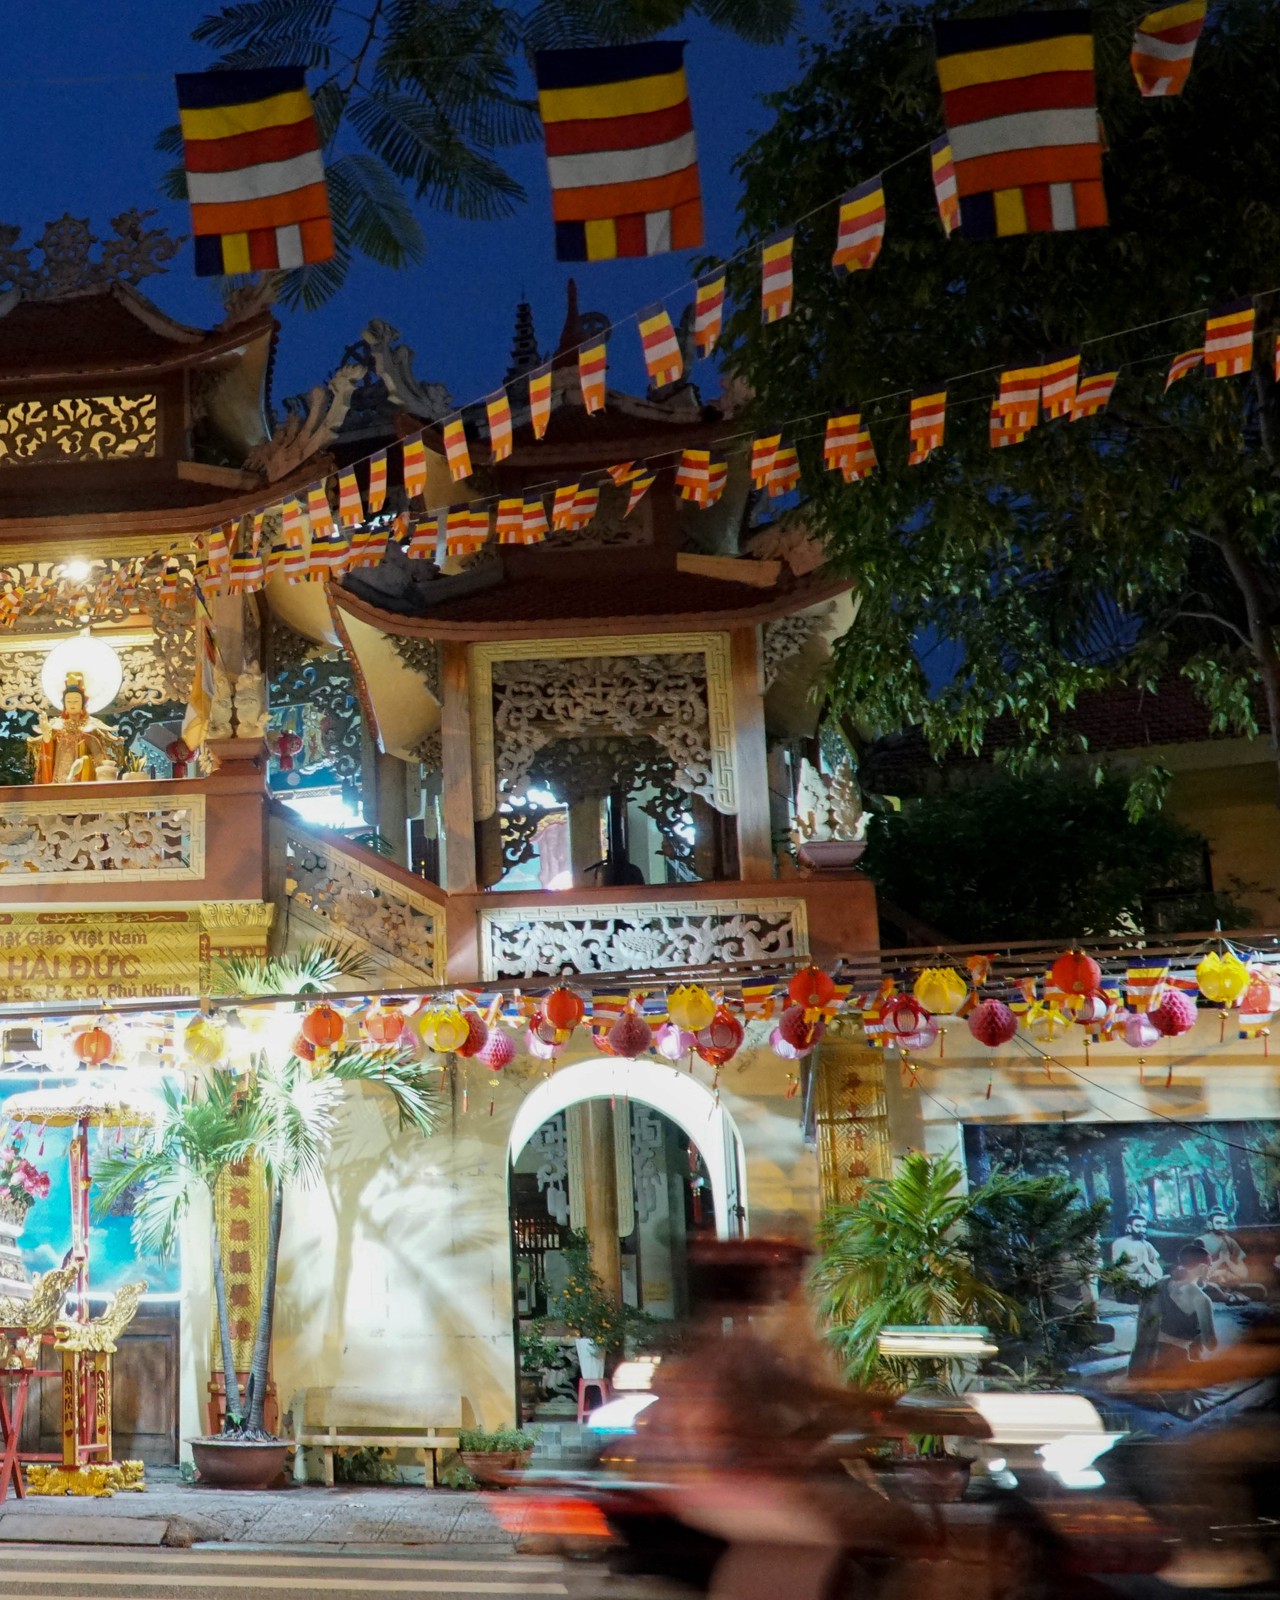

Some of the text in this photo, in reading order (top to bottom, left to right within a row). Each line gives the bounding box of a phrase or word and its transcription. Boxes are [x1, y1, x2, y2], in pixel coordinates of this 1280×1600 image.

[71, 930, 104, 948] Việt
[109, 931, 148, 945] Nam
[7, 949, 60, 980] HẢI
[70, 949, 141, 980] ĐỨC
